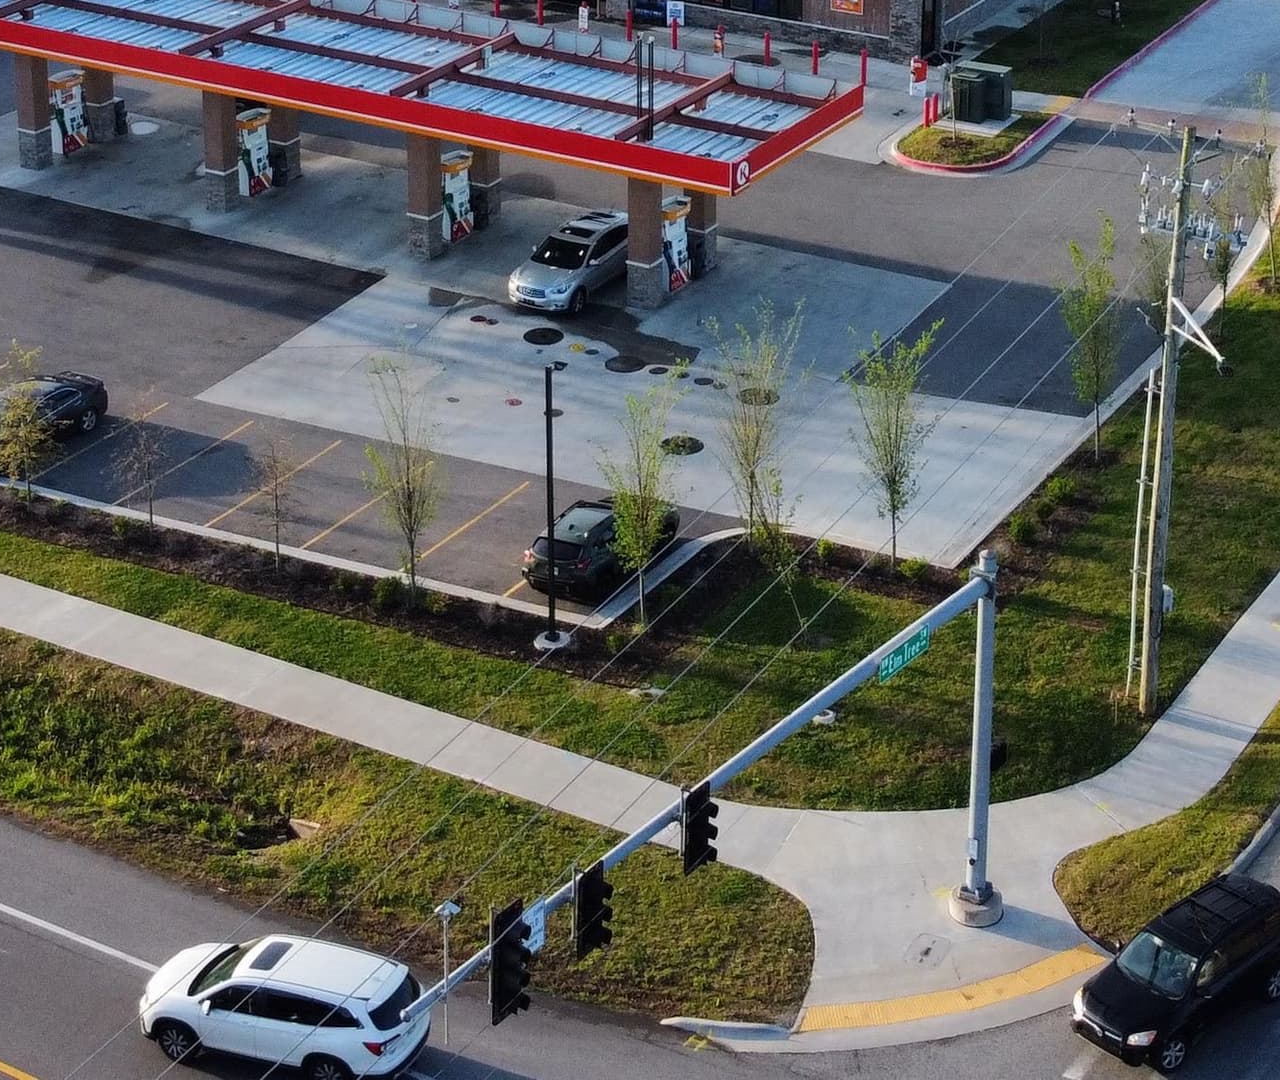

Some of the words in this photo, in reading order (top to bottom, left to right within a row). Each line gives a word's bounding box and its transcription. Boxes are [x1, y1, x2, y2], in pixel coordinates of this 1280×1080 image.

[738, 163, 749, 182] K
[888, 652, 903, 674] Elm
[903, 641, 921, 662] Tree
